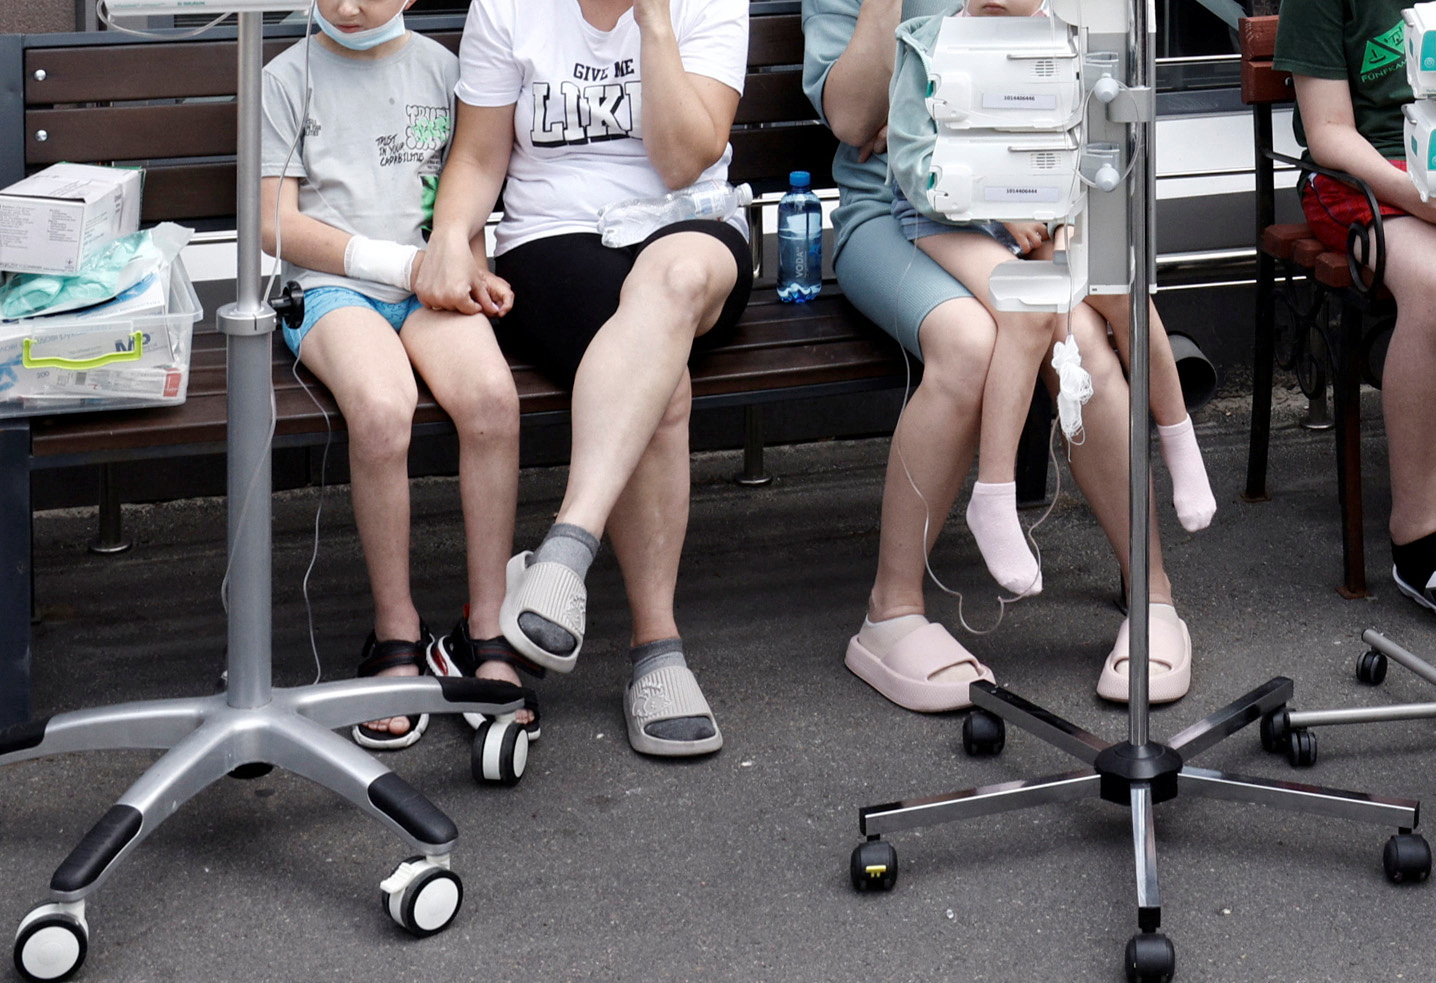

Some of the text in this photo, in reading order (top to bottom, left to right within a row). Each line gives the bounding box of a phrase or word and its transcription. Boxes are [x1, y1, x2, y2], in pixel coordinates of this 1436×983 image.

[573, 59, 635, 82] GIVE ME
[379, 147, 387, 157] IN
[795, 251, 804, 278] VODA
